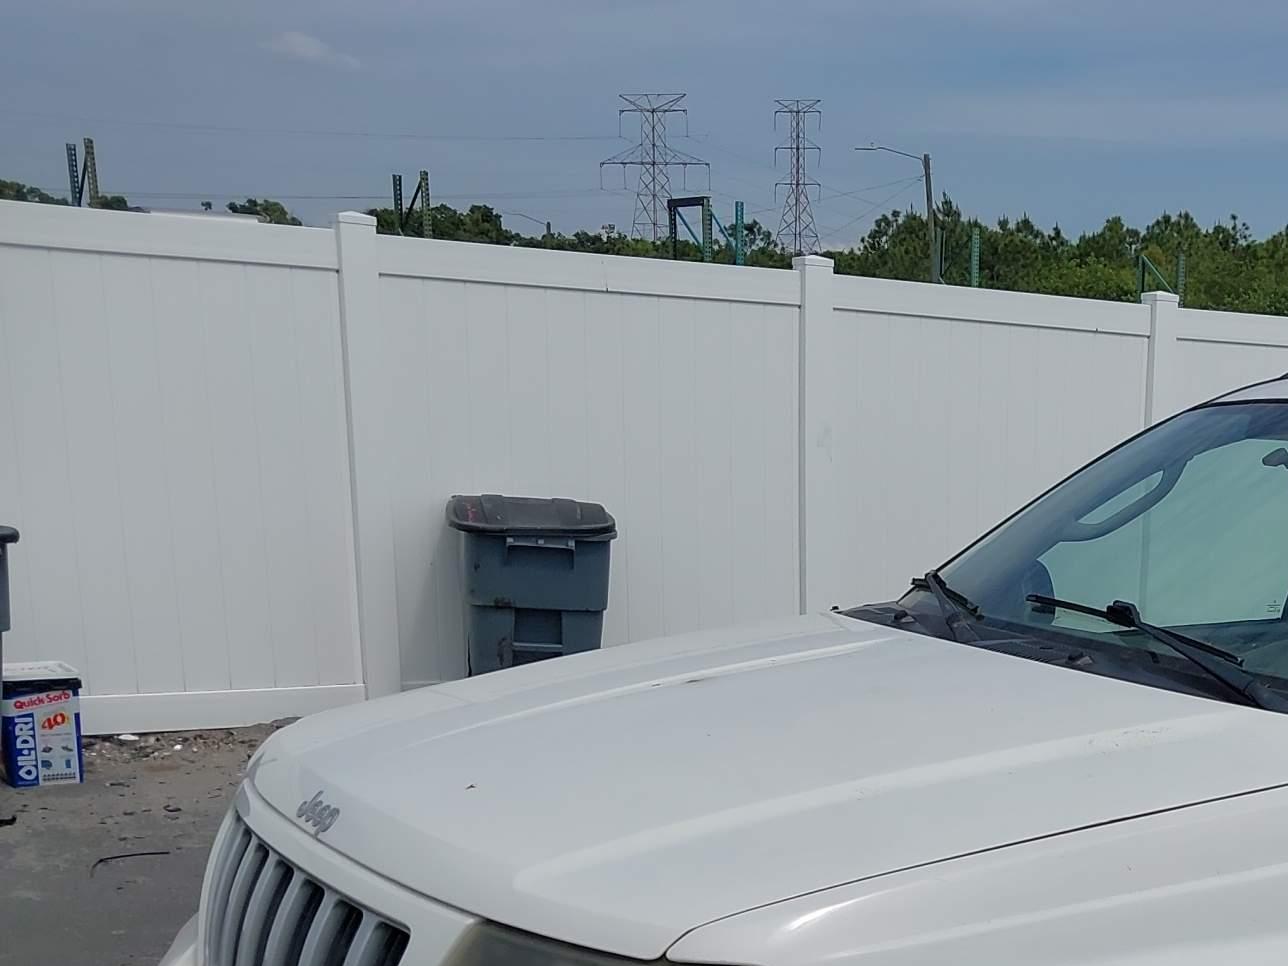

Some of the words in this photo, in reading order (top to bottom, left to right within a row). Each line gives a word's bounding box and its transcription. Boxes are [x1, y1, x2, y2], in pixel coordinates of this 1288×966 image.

[14, 696, 45, 709] Quick
[46, 690, 71, 704] Sorb
[41, 712, 66, 731] 40
[296, 790, 340, 837] Jeep
